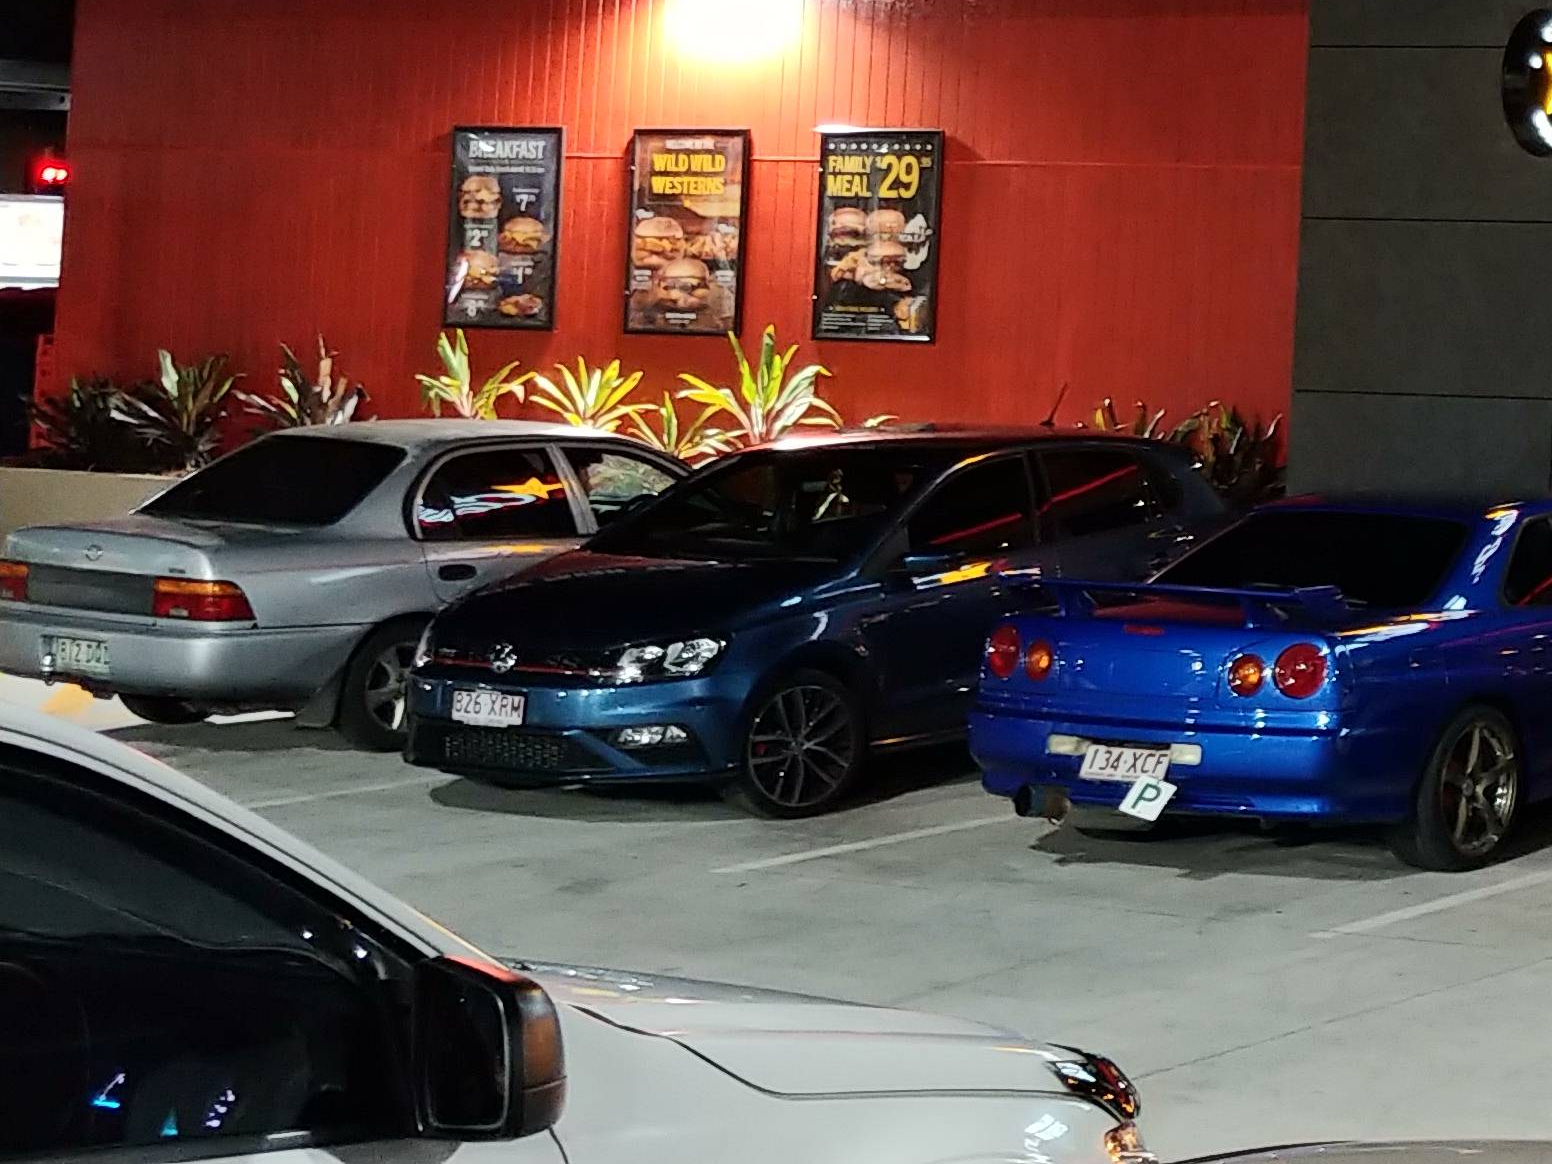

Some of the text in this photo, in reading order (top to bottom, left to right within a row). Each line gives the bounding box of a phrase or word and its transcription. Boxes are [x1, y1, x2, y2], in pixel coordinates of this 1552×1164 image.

[652, 153, 726, 173] WILD WILD
[827, 155, 873, 173] FAMILY
[651, 176, 725, 196] WESTERNS
[827, 174, 873, 197] MEAL
[1131, 782, 1162, 809] P
